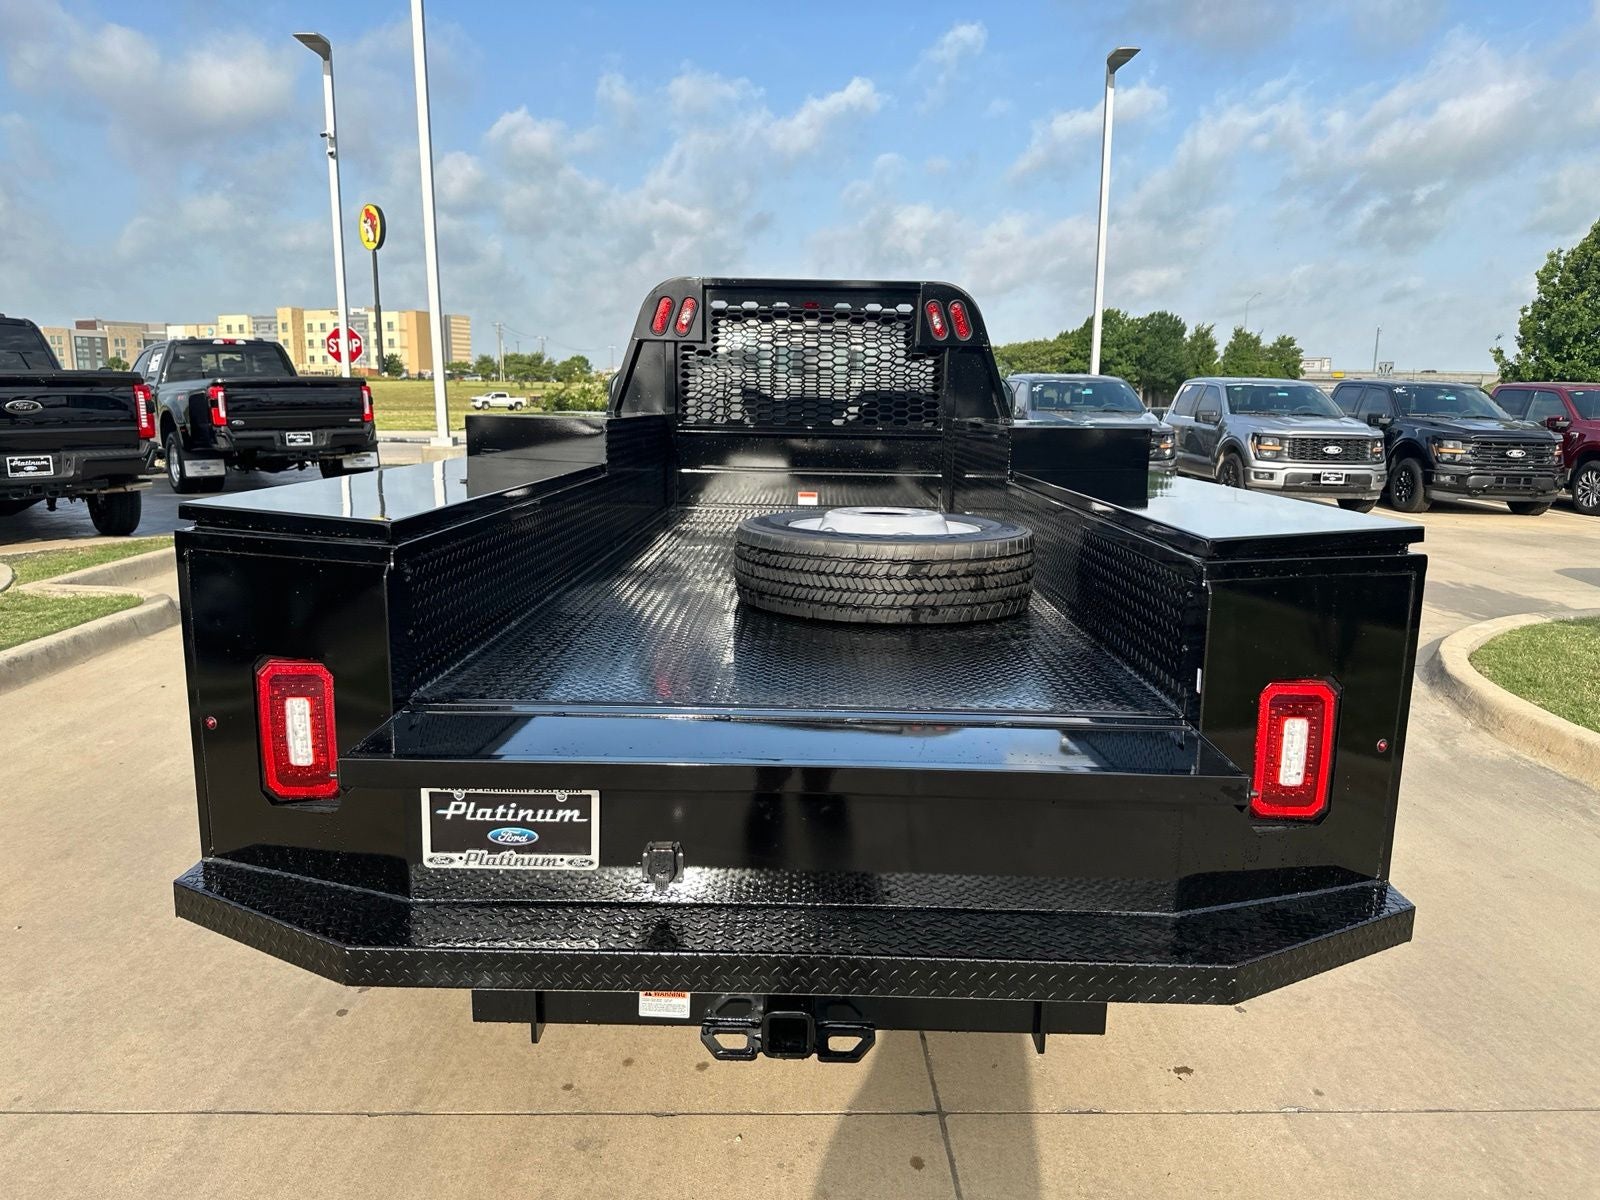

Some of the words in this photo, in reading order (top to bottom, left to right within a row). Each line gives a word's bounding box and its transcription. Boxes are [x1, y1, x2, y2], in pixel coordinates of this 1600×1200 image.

[328, 338, 360, 352] STP
[436, 802, 588, 822] Platinum
[497, 830, 528, 843] Ford
[464, 851, 564, 867] Platinum
